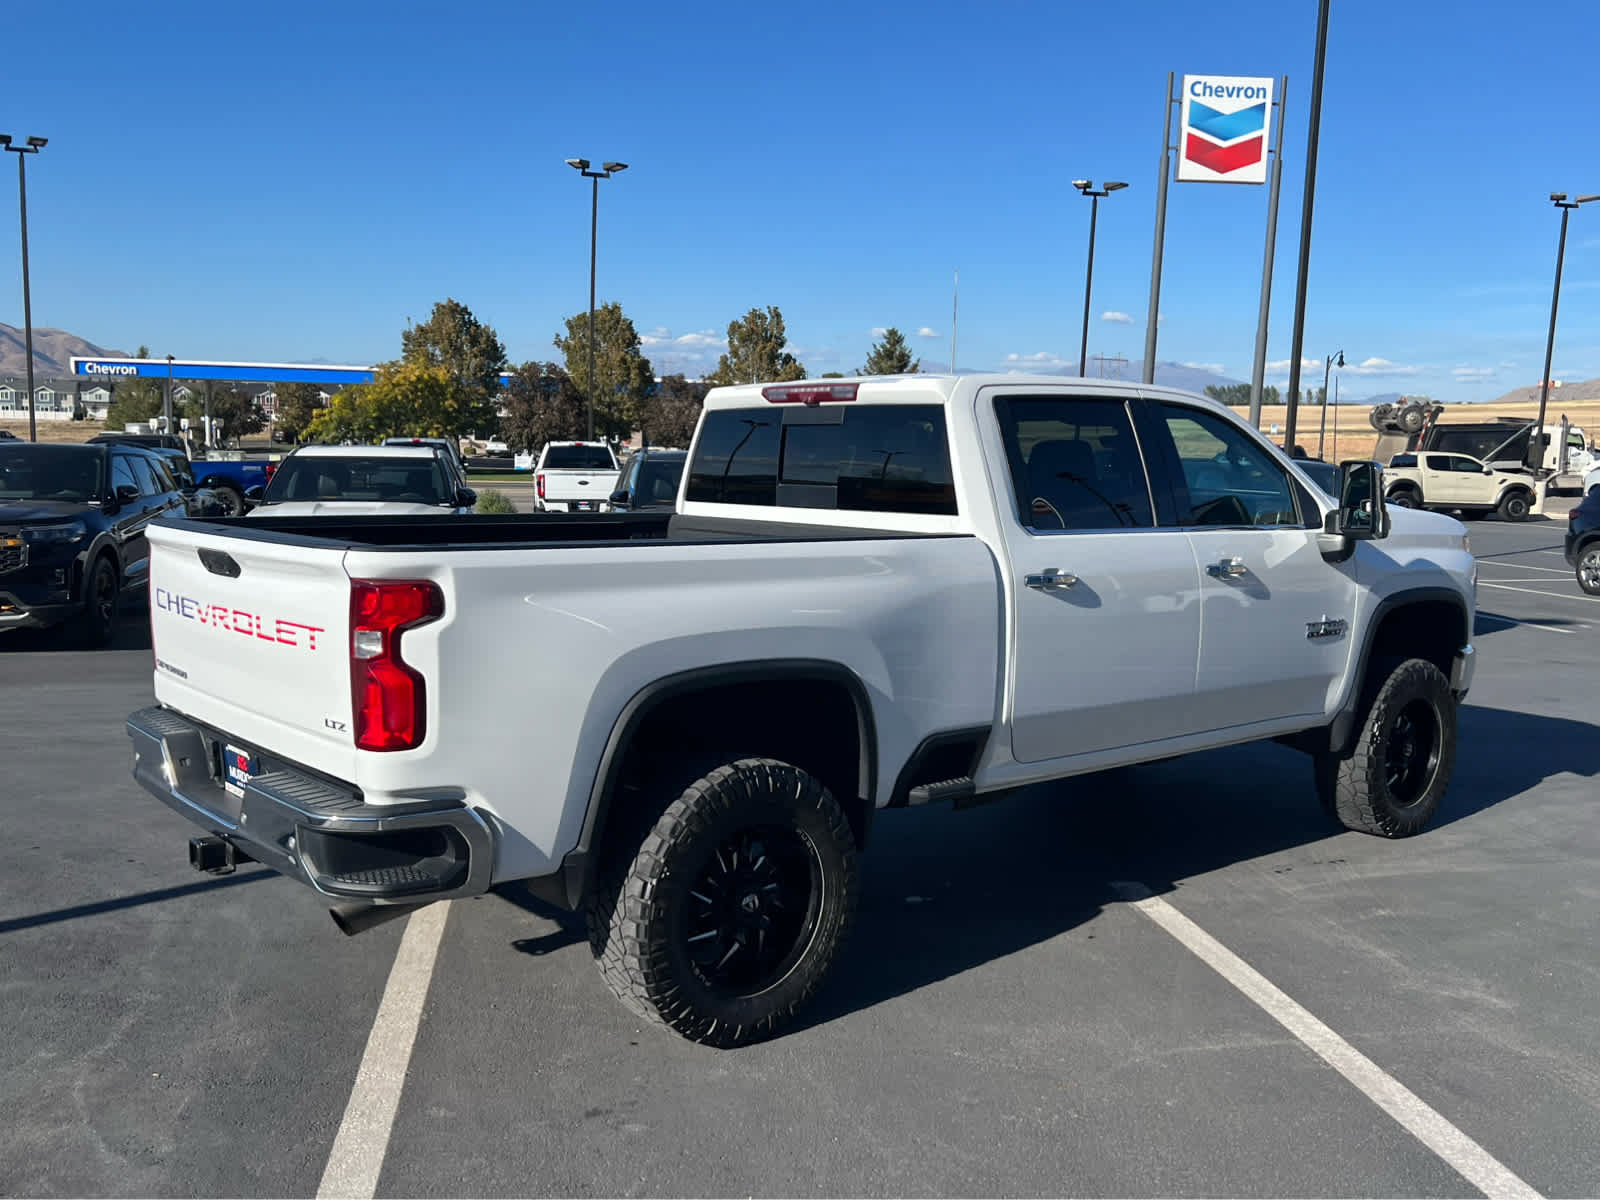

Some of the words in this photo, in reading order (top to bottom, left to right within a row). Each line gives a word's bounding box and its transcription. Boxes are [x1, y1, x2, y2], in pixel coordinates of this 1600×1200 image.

[1190, 80, 1267, 99] Chevron
[85, 362, 137, 375] Chevron
[156, 587, 325, 650] CHEVROLET
[324, 718, 347, 732] LTZ
